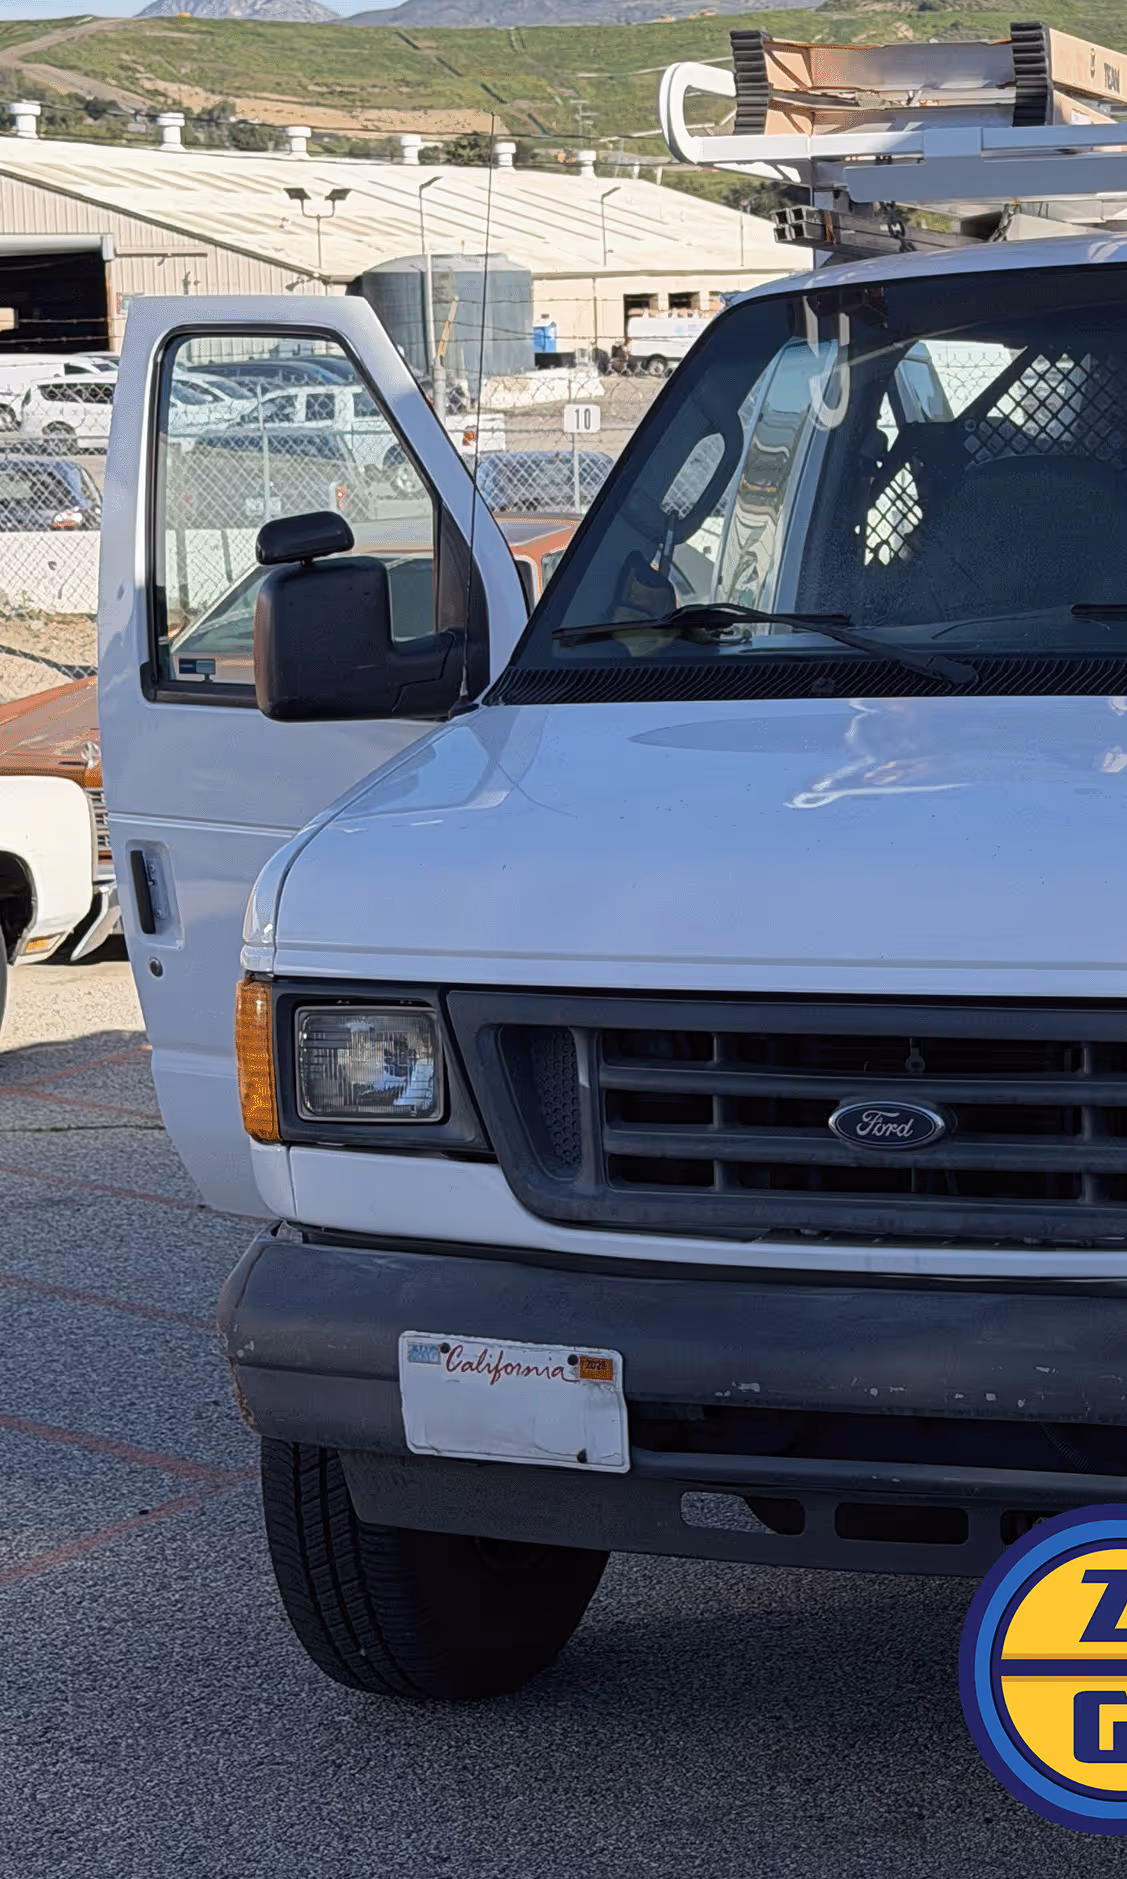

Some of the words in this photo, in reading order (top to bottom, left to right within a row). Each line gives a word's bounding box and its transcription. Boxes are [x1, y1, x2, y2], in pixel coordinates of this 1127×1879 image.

[575, 408, 591, 430] 10
[856, 1110, 914, 1137] Ford
[446, 1345, 580, 1385] California
